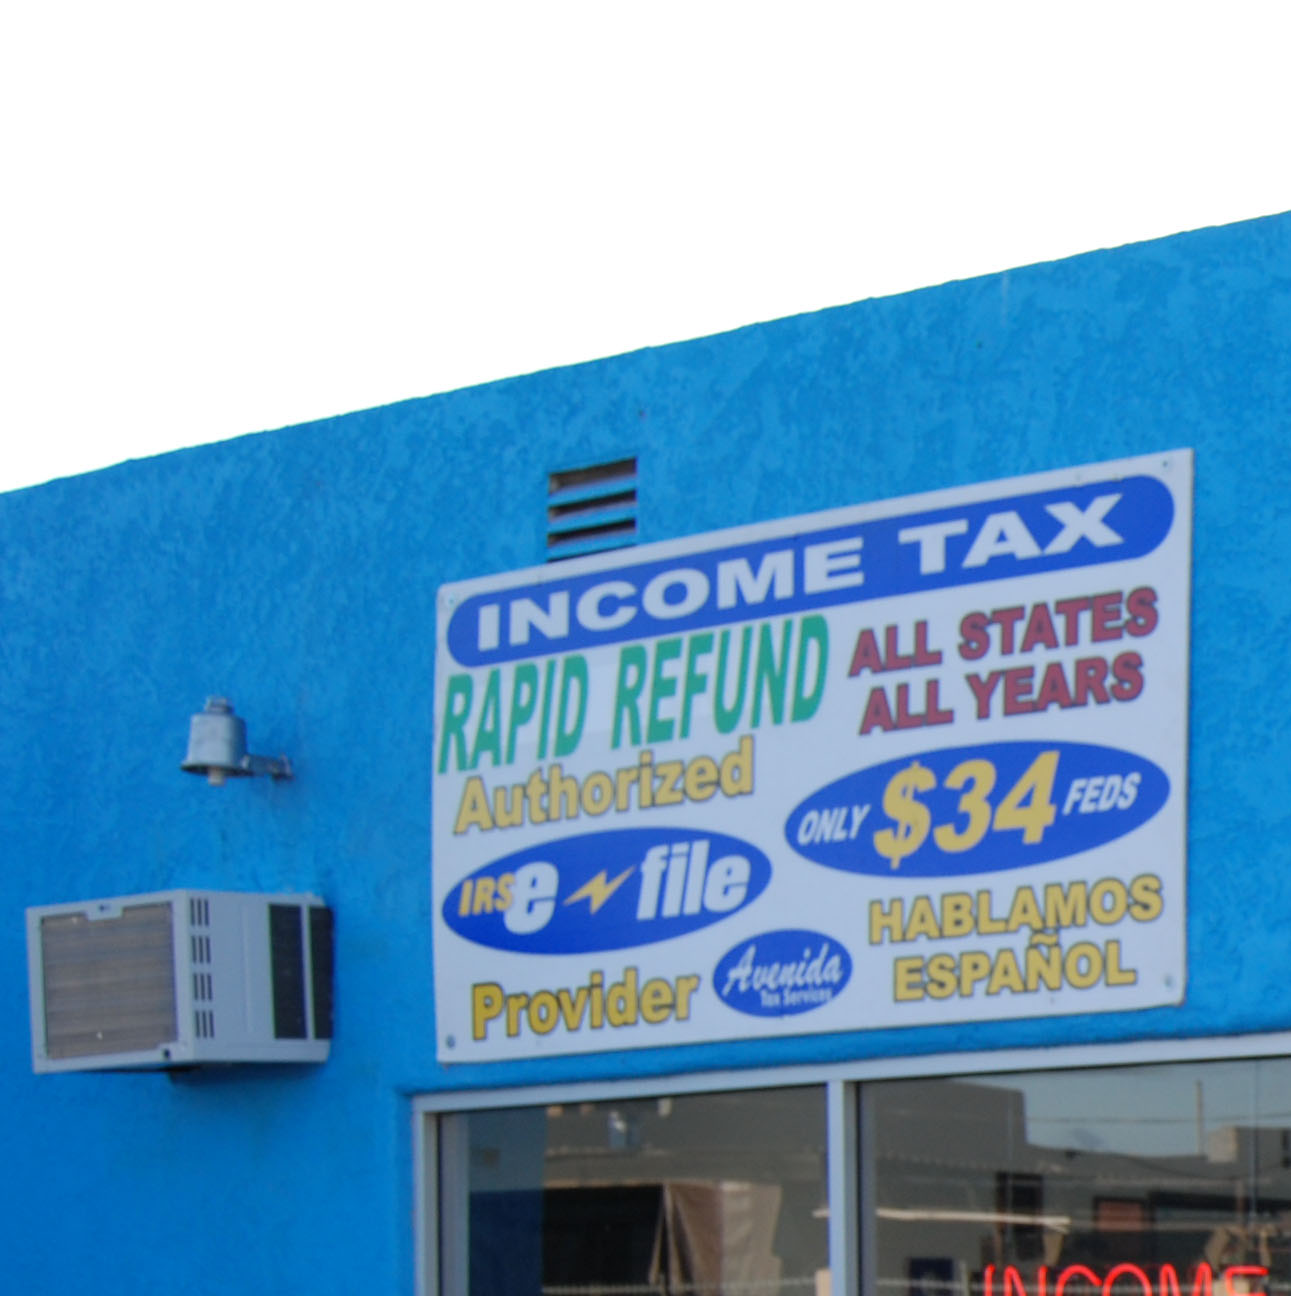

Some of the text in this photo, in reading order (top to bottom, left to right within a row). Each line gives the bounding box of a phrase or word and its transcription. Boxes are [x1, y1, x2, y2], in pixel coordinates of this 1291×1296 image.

[477, 493, 1125, 652] INCOME TAX
[848, 587, 1159, 676] ALL STATES
[437, 614, 829, 774] RAPID REFUND
[859, 652, 1145, 735] ALL YEARS
[452, 736, 754, 835] Authorized
[797, 750, 1141, 869] ONLY $34 FEDS
[458, 873, 514, 917] IRS
[636, 840, 751, 921] file
[868, 875, 1163, 945] HABLAMOS
[471, 968, 699, 1040] Provider
[722, 941, 843, 997] Avenida
[893, 929, 1136, 1002] ESPAÑOL
